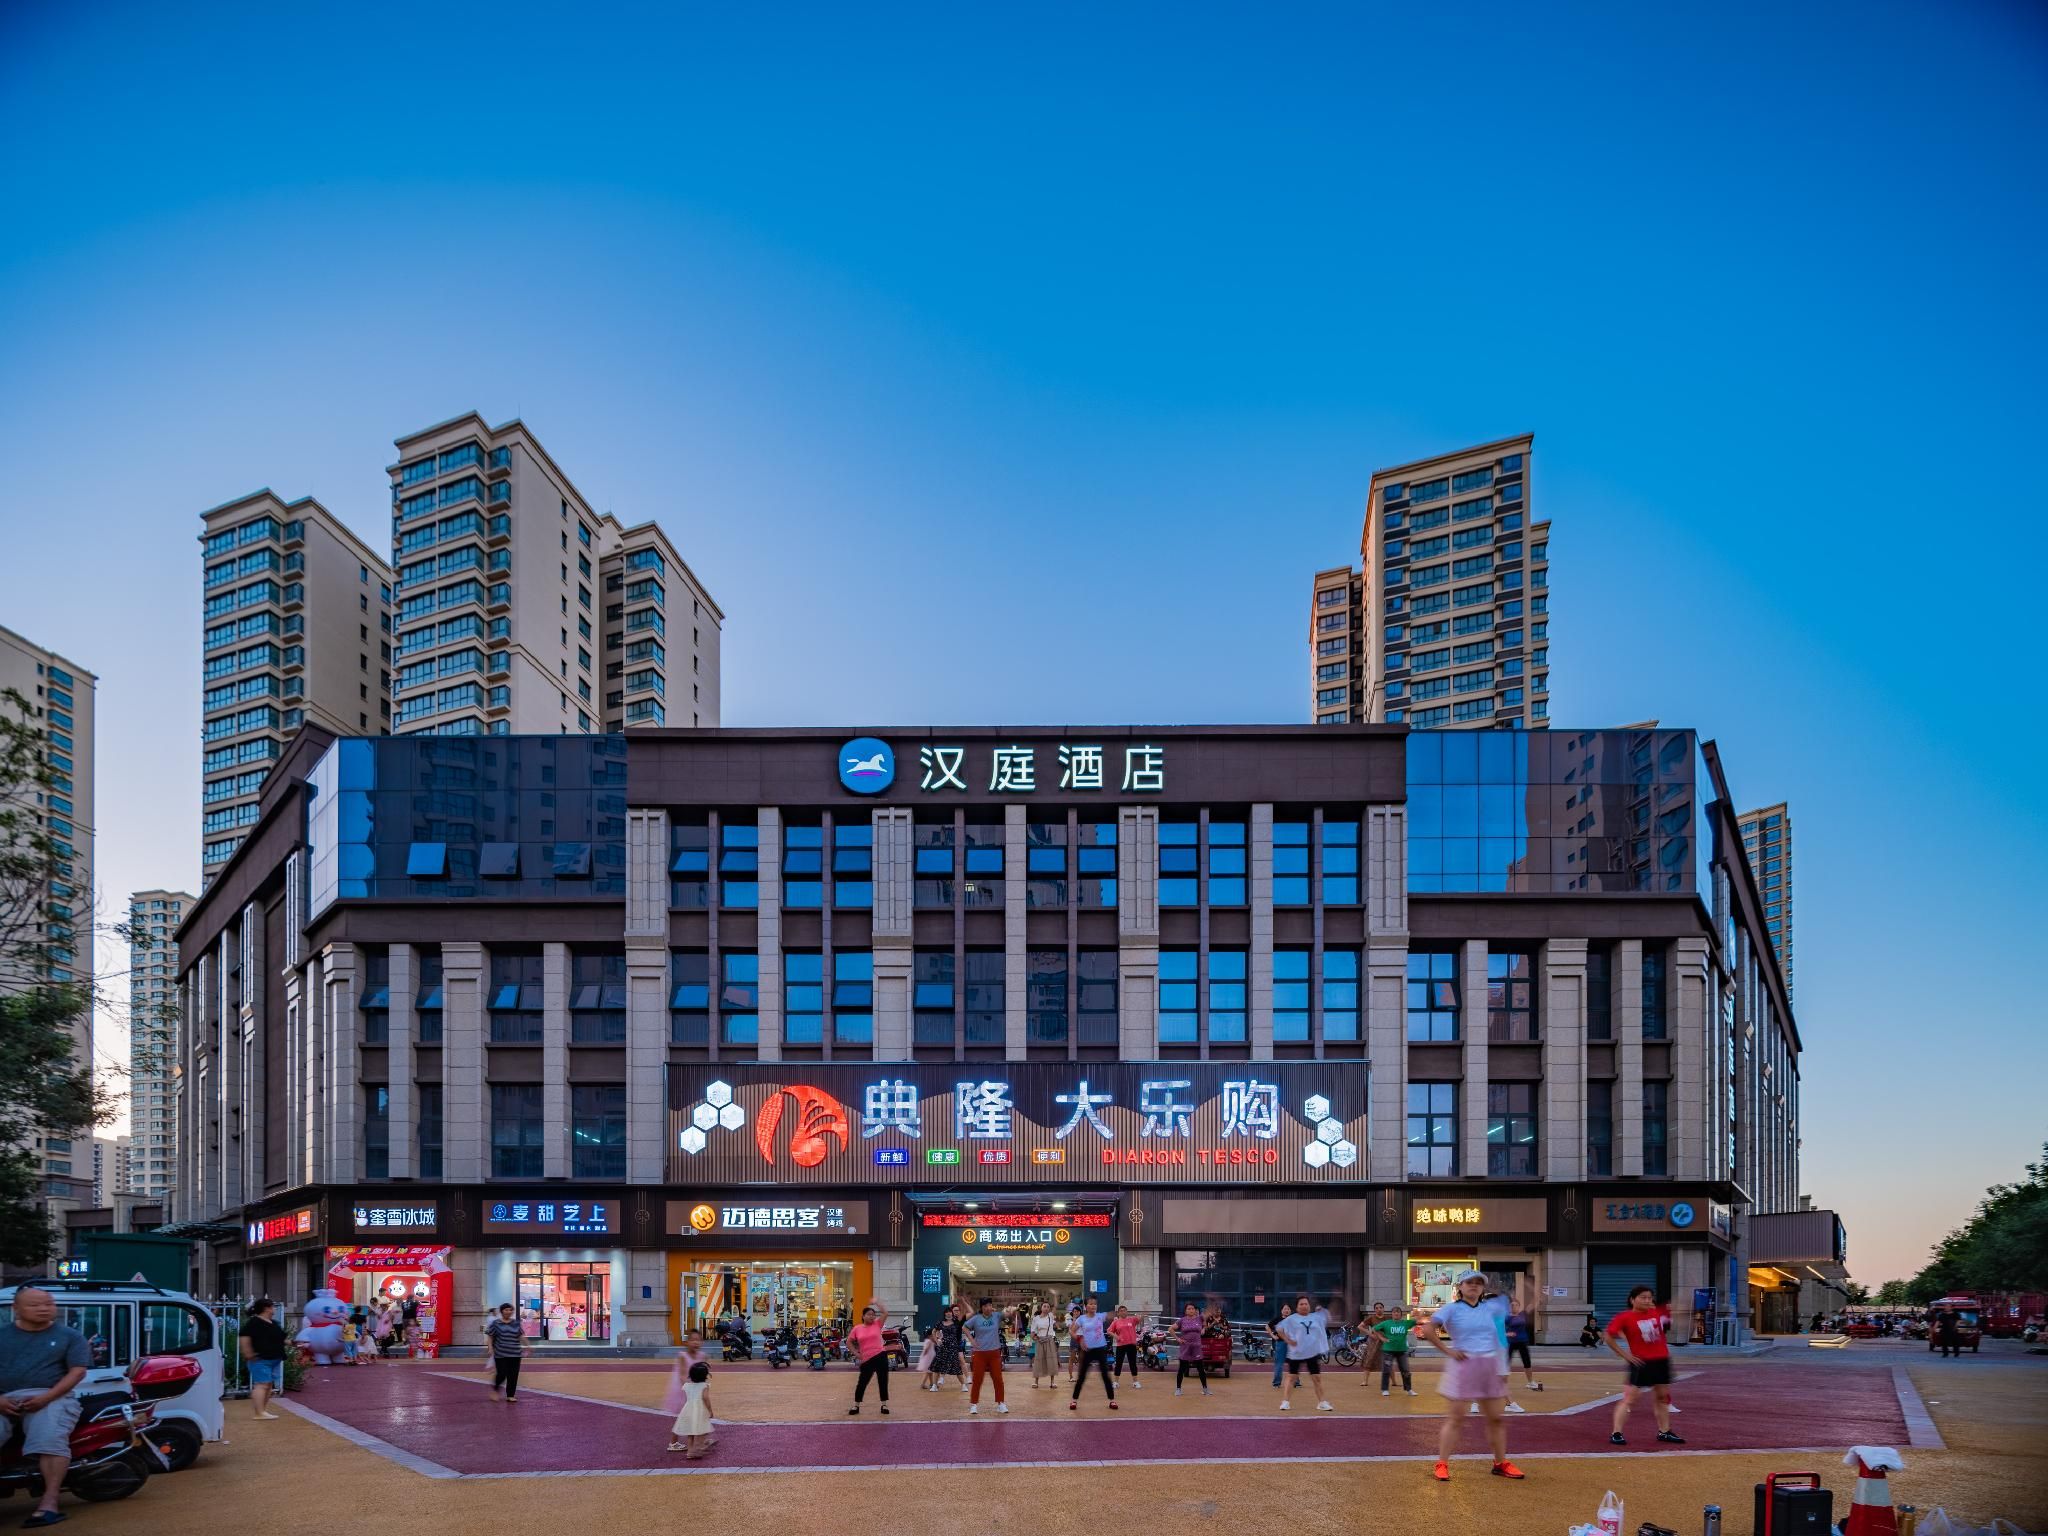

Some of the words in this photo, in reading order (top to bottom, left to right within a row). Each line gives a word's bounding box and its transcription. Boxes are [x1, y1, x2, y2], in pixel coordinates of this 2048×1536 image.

[920, 745, 1165, 791] 汉庭酒店
[860, 1079, 1281, 1141] 典隆大乐购
[880, 1151, 906, 1163] 新鲜
[931, 1151, 957, 1163] 健康
[982, 1151, 1008, 1163] 优质
[1036, 1151, 1061, 1163] 便利
[1102, 1149, 1185, 1165] DIARON
[1199, 1149, 1278, 1165] TESCO
[369, 1208, 435, 1226] 蜜雪冰城
[513, 1204, 605, 1222] 麦甜芝上
[722, 1207, 820, 1228] 迈德思客
[826, 1208, 843, 1216] 汉堡
[1416, 1207, 1481, 1223] 绝味鸭脖
[979, 1229, 1052, 1243] 商场出入口
